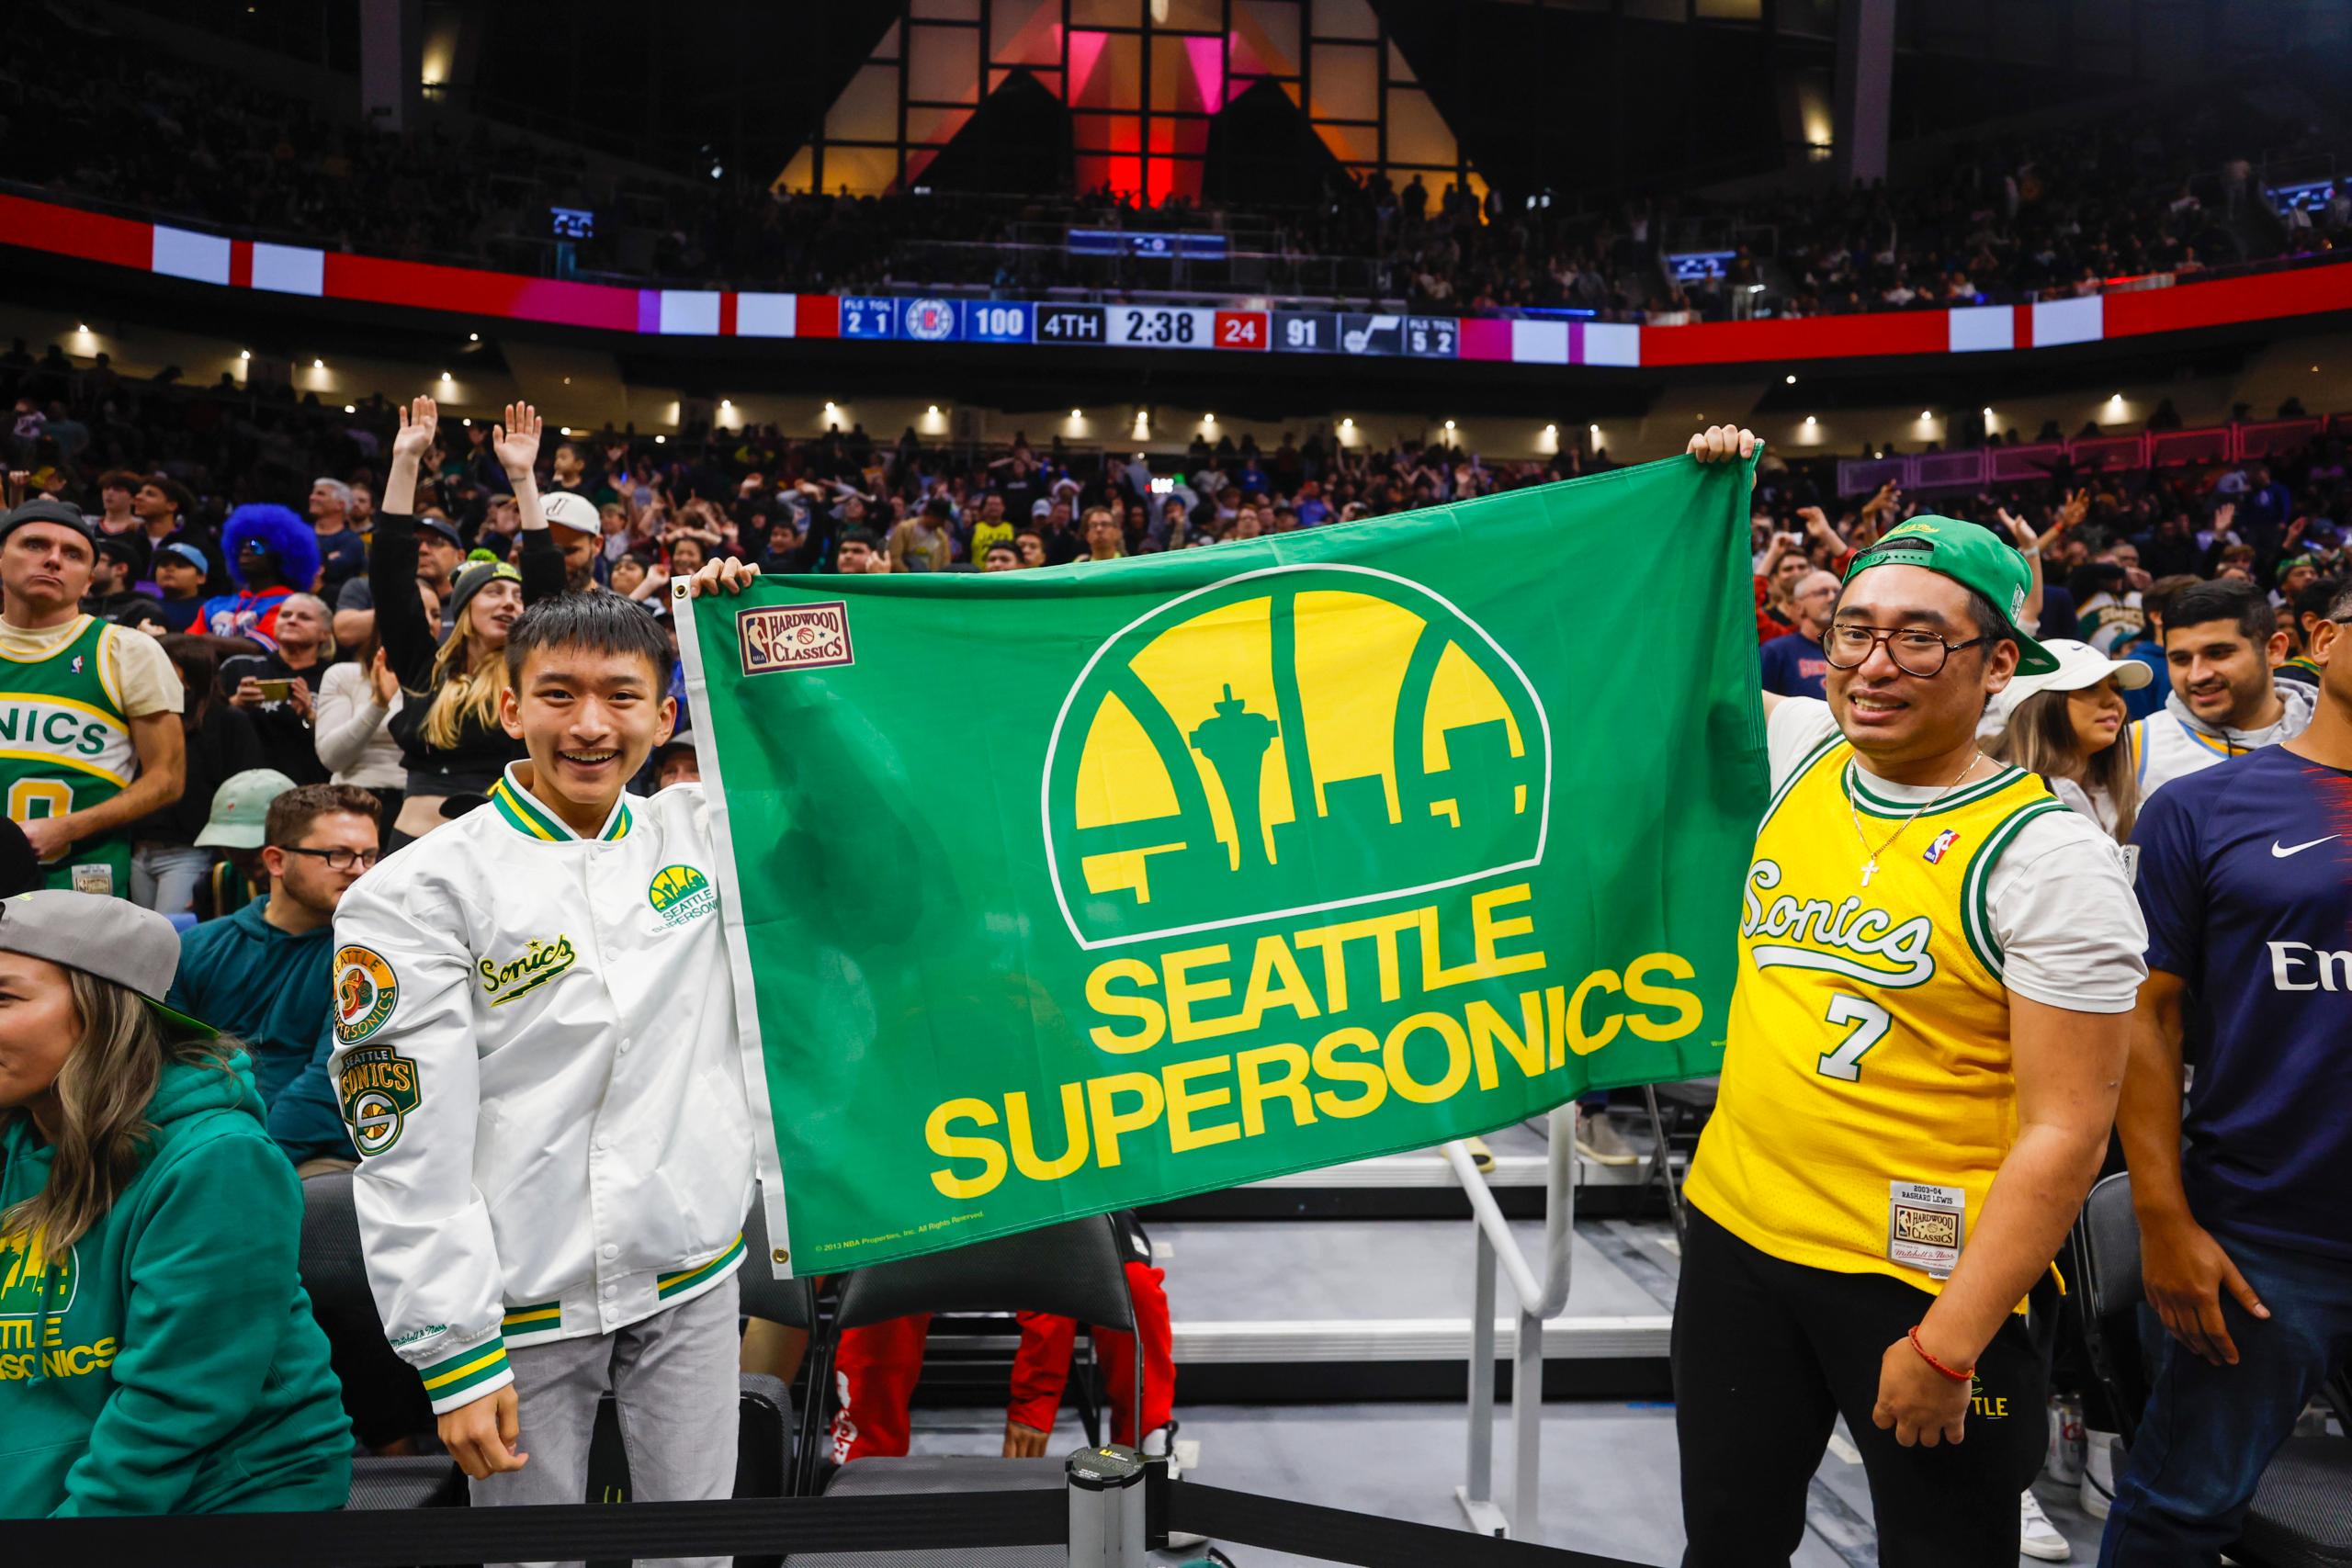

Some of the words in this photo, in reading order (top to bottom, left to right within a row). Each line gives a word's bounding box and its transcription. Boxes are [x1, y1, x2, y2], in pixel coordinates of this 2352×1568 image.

[848, 312, 861, 333] 2
[876, 313, 887, 333] 1
[976, 308, 1024, 335] 100
[1044, 314, 1098, 337] 4TH
[1126, 311, 1194, 343] 2:38
[1225, 320, 1256, 343] 24
[1287, 319, 1317, 346] 91
[1412, 332, 1426, 353] 5
[1438, 333, 1452, 353] 2
[768, 612, 839, 641] HARDWOOD
[773, 636, 842, 662] CLASSICS
[651, 899, 718, 933] SUPERSON
[662, 888, 714, 921] SEATTLE
[1742, 858, 1936, 988] Sonics
[334, 950, 382, 977] EATTLE
[479, 934, 578, 996] Sonics
[1085, 882, 1546, 1055] SEATTLE
[1817, 992, 1892, 1082] 7
[345, 1050, 389, 1070] SEATTLE
[342, 1062, 412, 1103] SONICS
[924, 953, 1703, 1200] SUPERSONICS
[1902, 1191, 1930, 1201] RASHARD
[1932, 1195, 1953, 1205] LEWIS
[1914, 1185, 1942, 1195] 2003-04
[843, 1240, 860, 1249] NBA
[918, 1224, 927, 1234] All
[929, 1218, 951, 1231] Rights
[1913, 1212, 1953, 1230] HARDWOOD
[1912, 1227, 1953, 1244] CLASSICS
[0, 1317, 62, 1349] TTLE
[0, 1337, 118, 1381] SONICS
